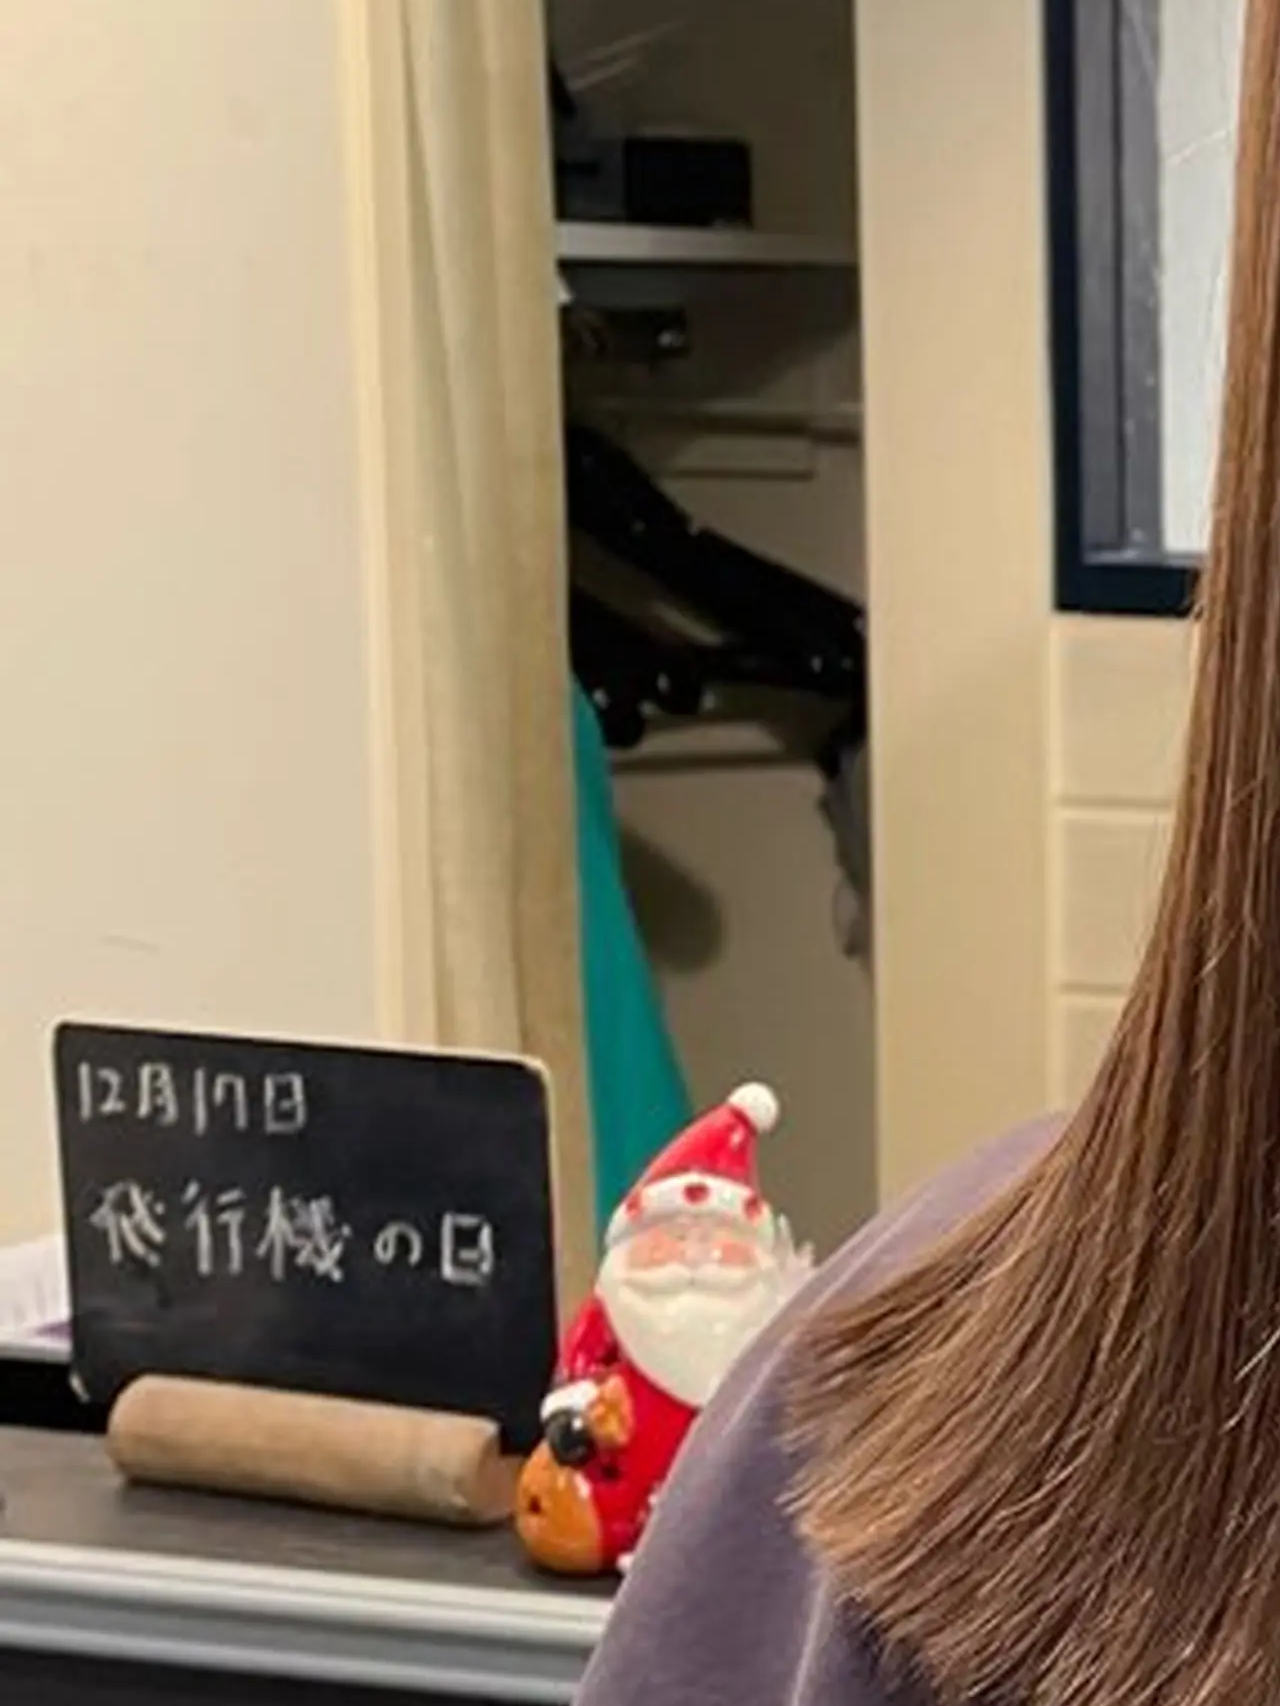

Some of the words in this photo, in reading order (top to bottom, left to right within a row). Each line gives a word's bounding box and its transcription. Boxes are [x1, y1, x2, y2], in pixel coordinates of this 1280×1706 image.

[78, 1061, 306, 1135] 12月17日
[89, 1180, 495, 1285] 飛行機の日
